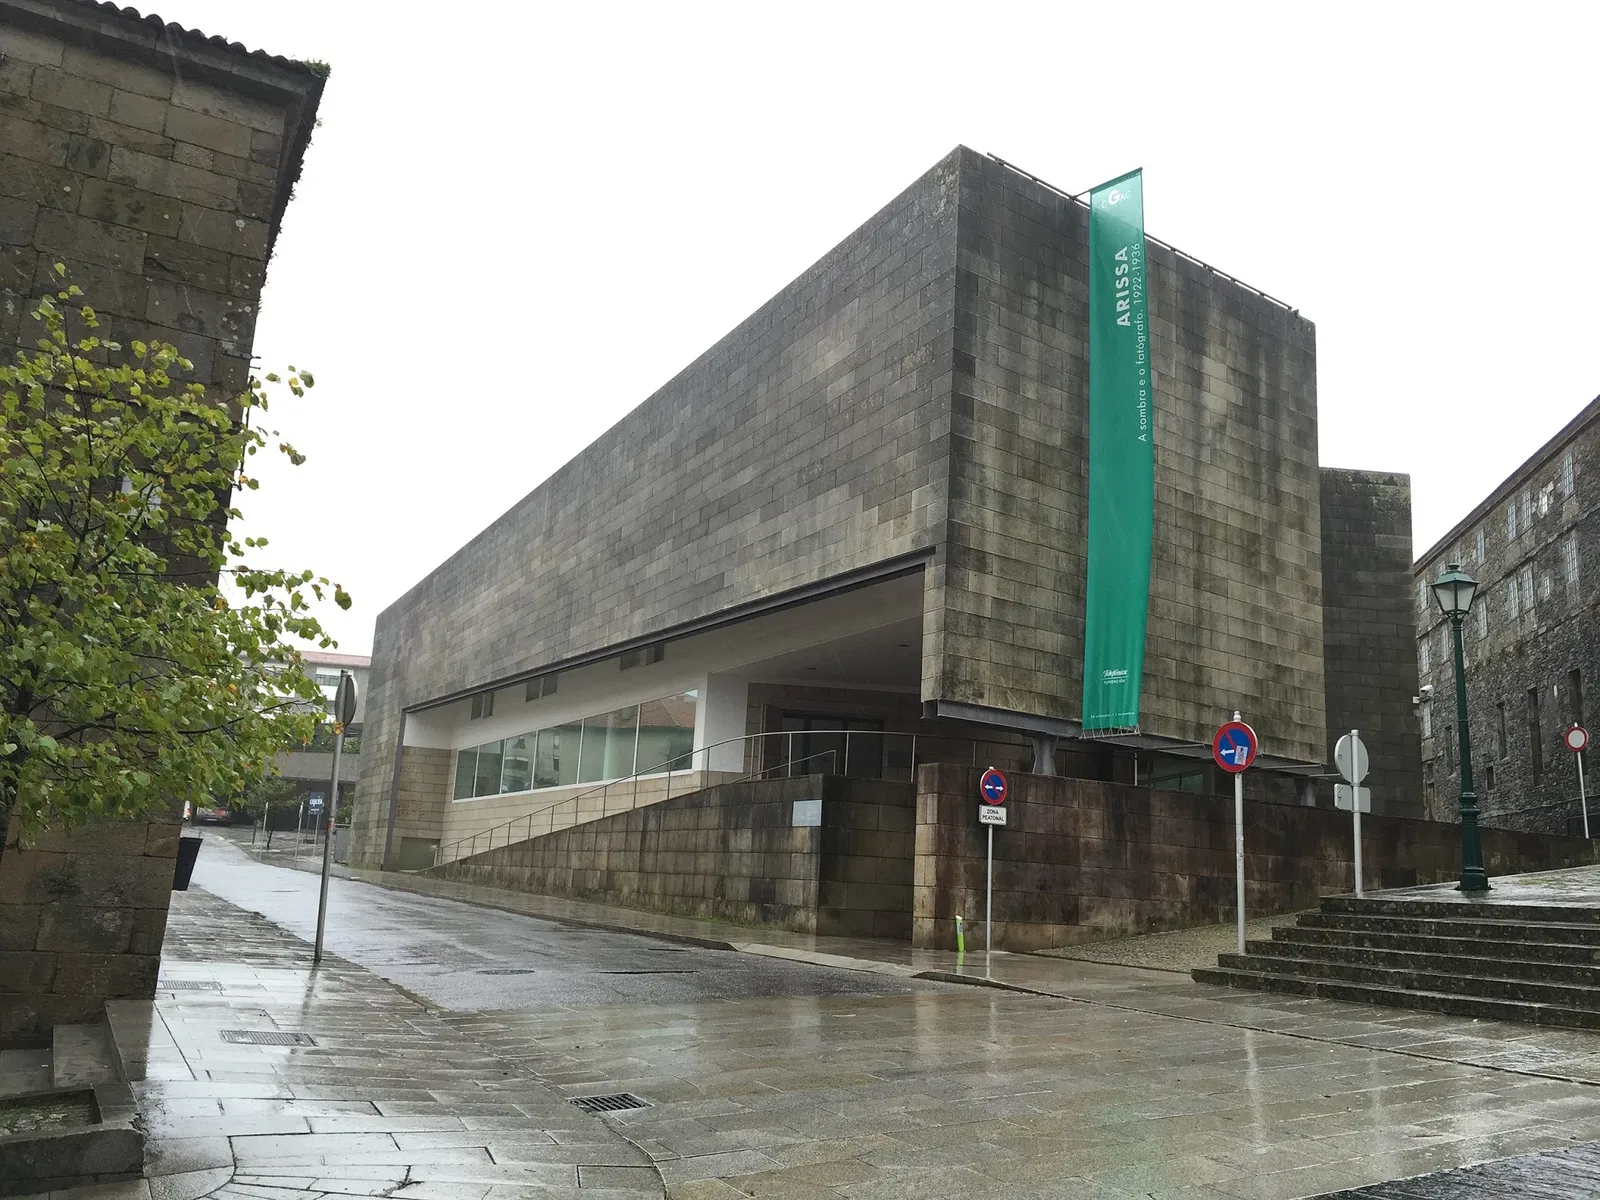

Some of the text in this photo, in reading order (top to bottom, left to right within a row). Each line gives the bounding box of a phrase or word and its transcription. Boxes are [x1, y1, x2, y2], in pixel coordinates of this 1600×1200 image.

[1101, 189, 1132, 209] CGAC
[1115, 246, 1131, 327] ARISSA
[1131, 243, 1142, 304] 1922-1936
[1134, 309, 1146, 364] fotógrafo.
[1139, 368, 1146, 376] o
[1137, 390, 1146, 430] sombra
[1138, 433, 1146, 442] A
